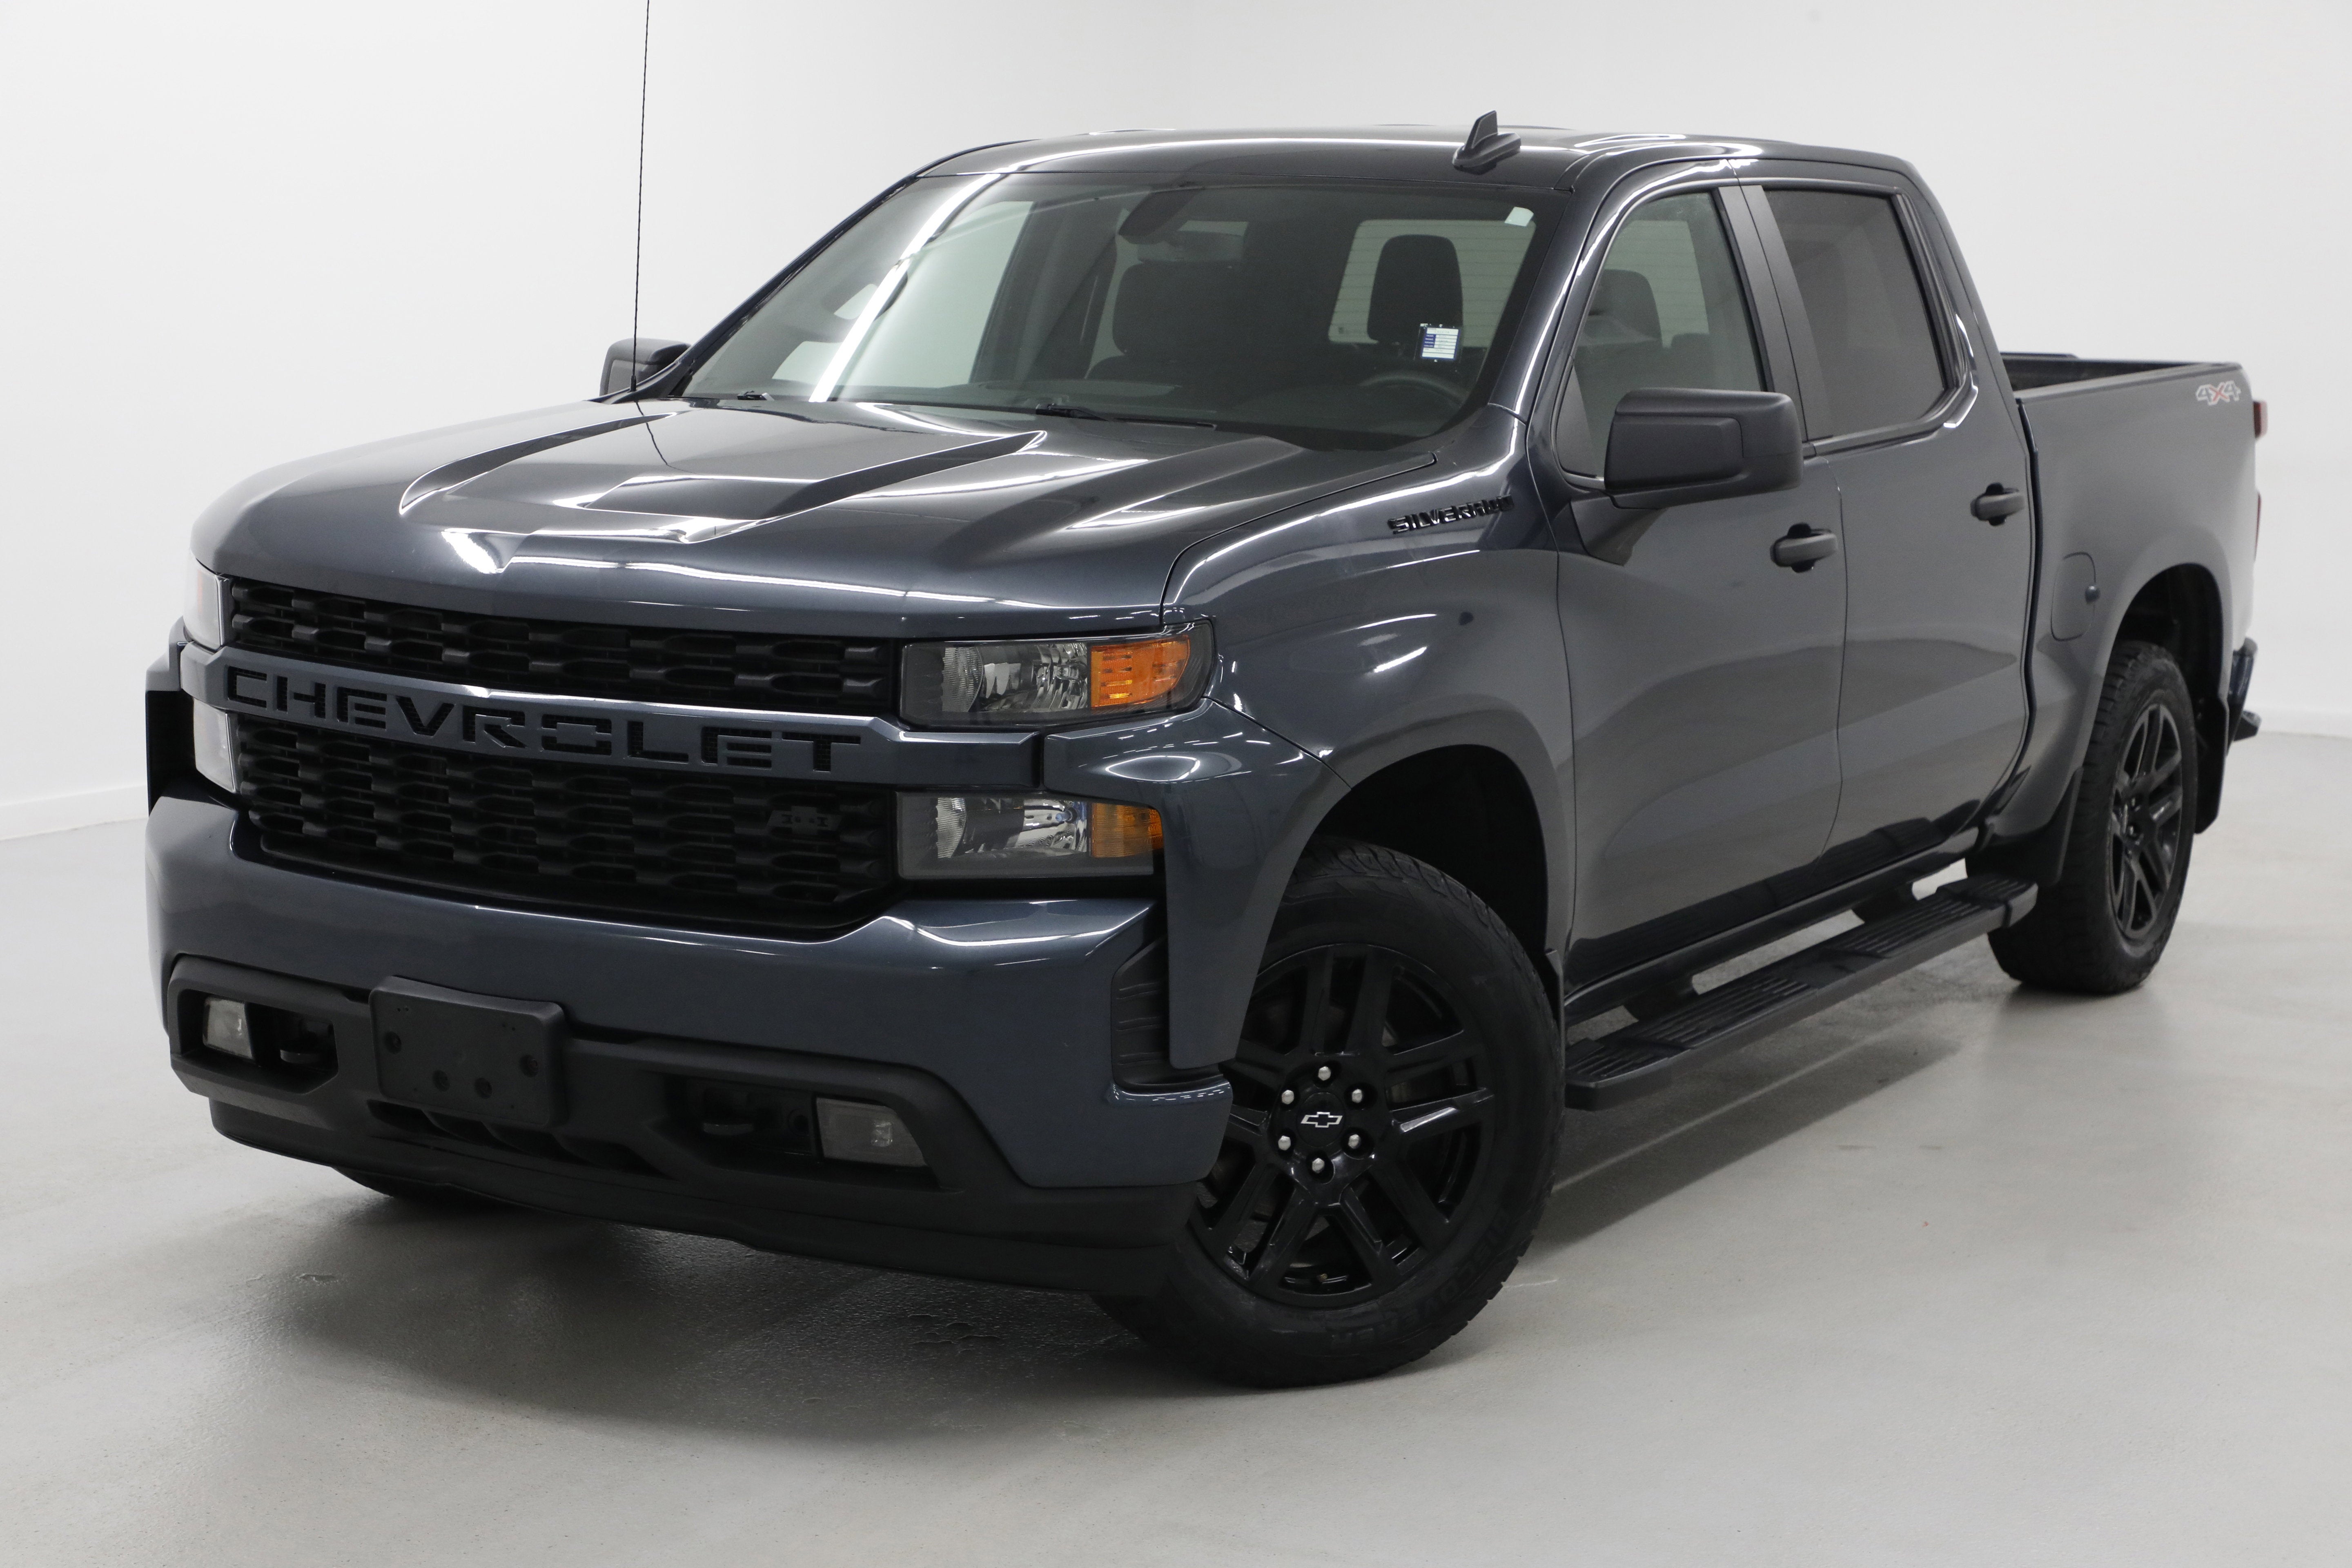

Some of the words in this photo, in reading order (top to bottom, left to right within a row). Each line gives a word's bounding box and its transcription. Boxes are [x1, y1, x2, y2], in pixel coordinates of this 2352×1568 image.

[2196, 380, 2241, 406] 4X4
[1387, 494, 1515, 535] SILVERADO
[227, 666, 861, 772] CHEVROLET
